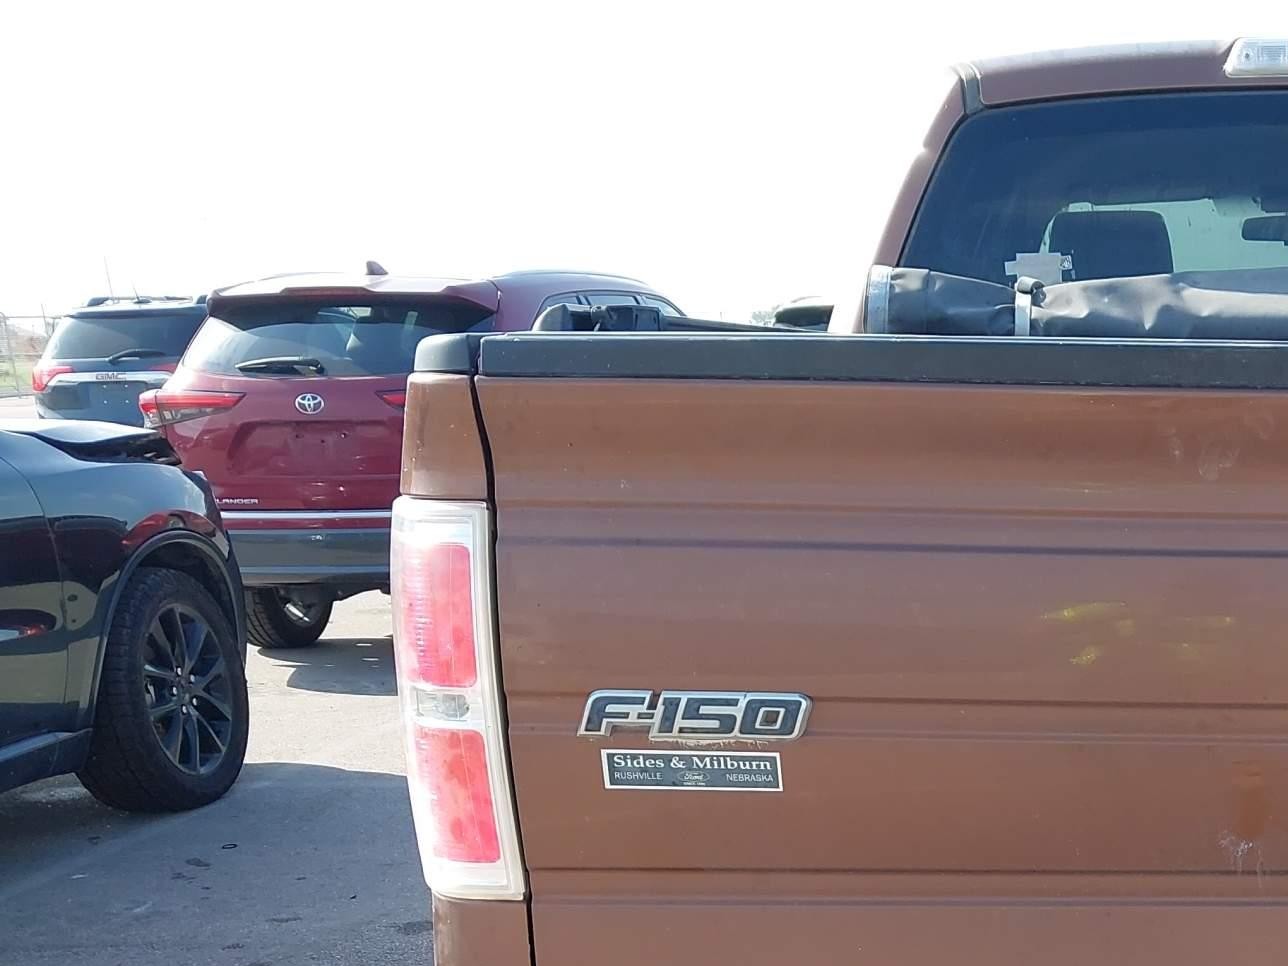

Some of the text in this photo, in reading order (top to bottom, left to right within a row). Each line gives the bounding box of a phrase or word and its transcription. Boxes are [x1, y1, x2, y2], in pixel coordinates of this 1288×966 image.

[577, 690, 812, 740] F-150
[613, 754, 772, 771] Sides & Milburn
[614, 771, 663, 781] RUSHVILLE
[725, 773, 774, 783] NEBRASKA
